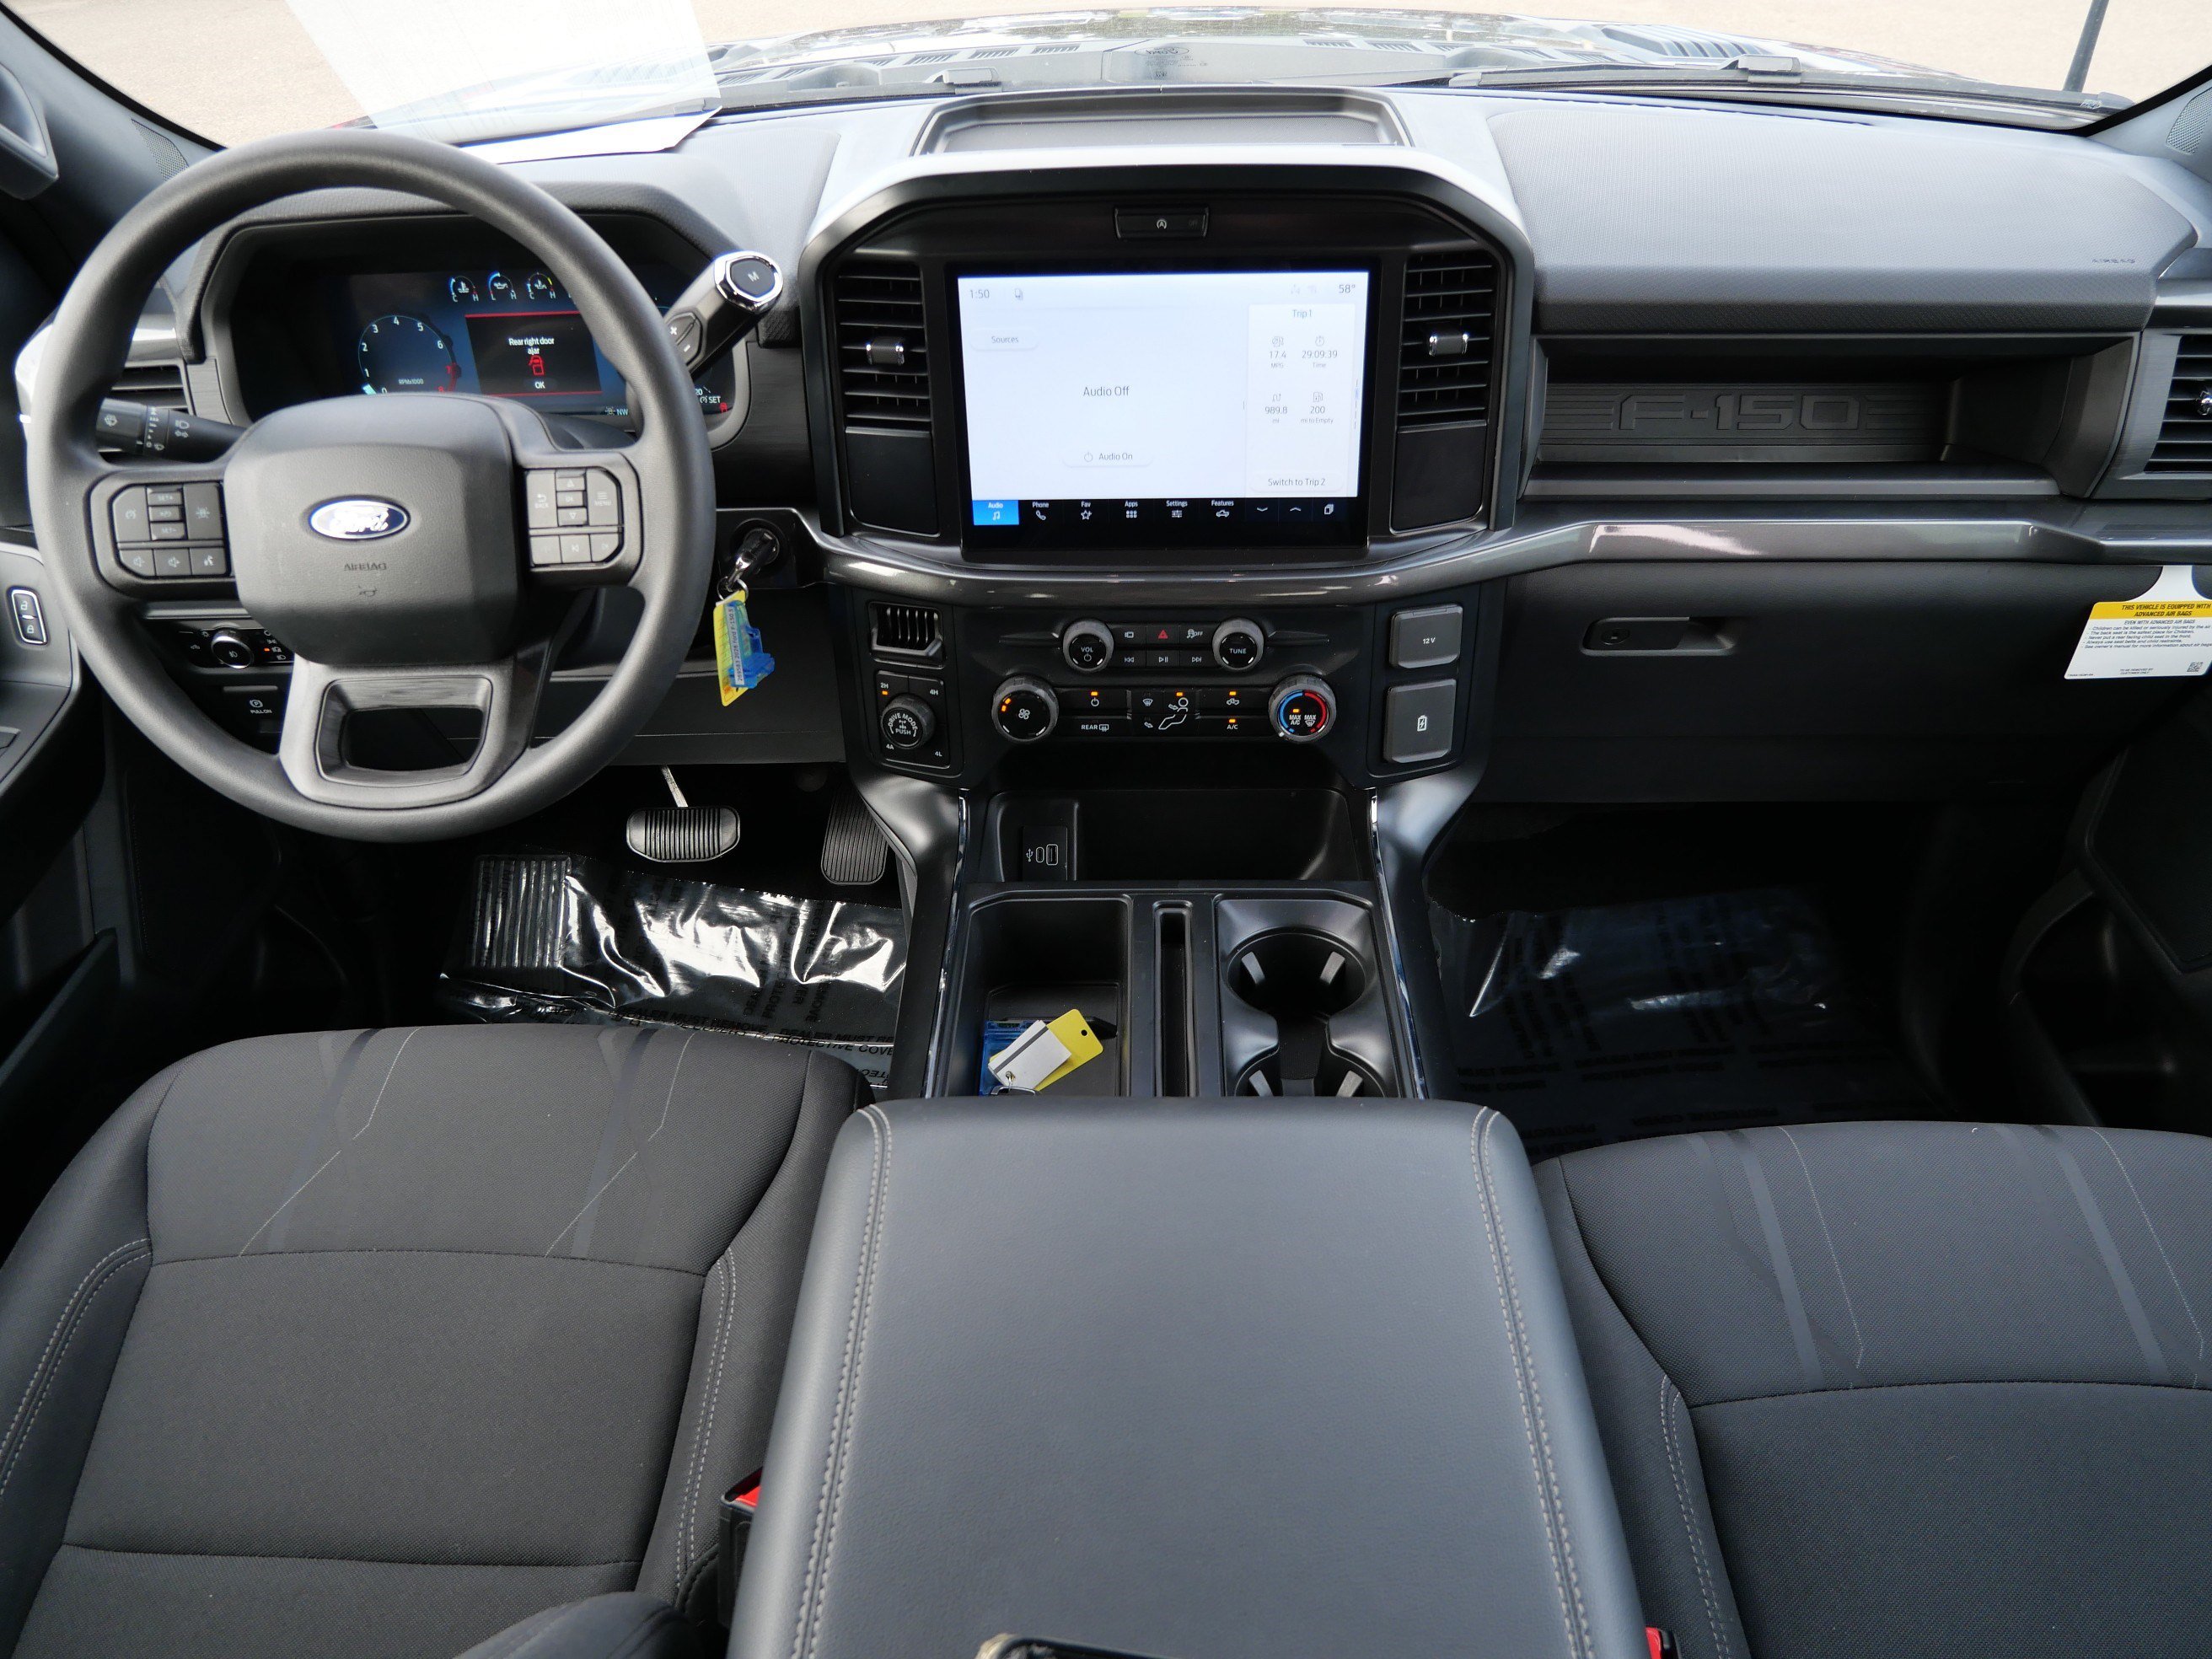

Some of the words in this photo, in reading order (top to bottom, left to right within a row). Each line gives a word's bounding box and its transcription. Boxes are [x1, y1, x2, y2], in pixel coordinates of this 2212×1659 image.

[748, 271, 760, 282] M
[1339, 284, 1356, 294] 58°
[969, 289, 990, 299] 1:50
[1292, 309, 1307, 319] Trip
[394, 316, 400, 325] 4
[371, 325, 379, 334] 3
[417, 322, 424, 331] 5
[437, 340, 443, 349] 6
[524, 337, 540, 346] right
[540, 336, 555, 345] door
[991, 336, 1019, 345] Sources
[362, 342, 368, 352] 2
[1270, 351, 1286, 359] 17.4
[364, 368, 369, 378] 1
[445, 365, 451, 374] 7
[1083, 386, 1112, 397] Audio
[1114, 385, 1130, 397] Off
[1264, 406, 1288, 415] 989.8
[1619, 394, 1861, 431] F-150
[1098, 453, 1120, 461] Audio
[1268, 478, 1293, 486] Switch
[1305, 478, 1319, 487] Trip
[1166, 500, 1188, 508] Settings
[888, 712, 902, 727] DRIVE
[902, 713, 918, 730] MODE
